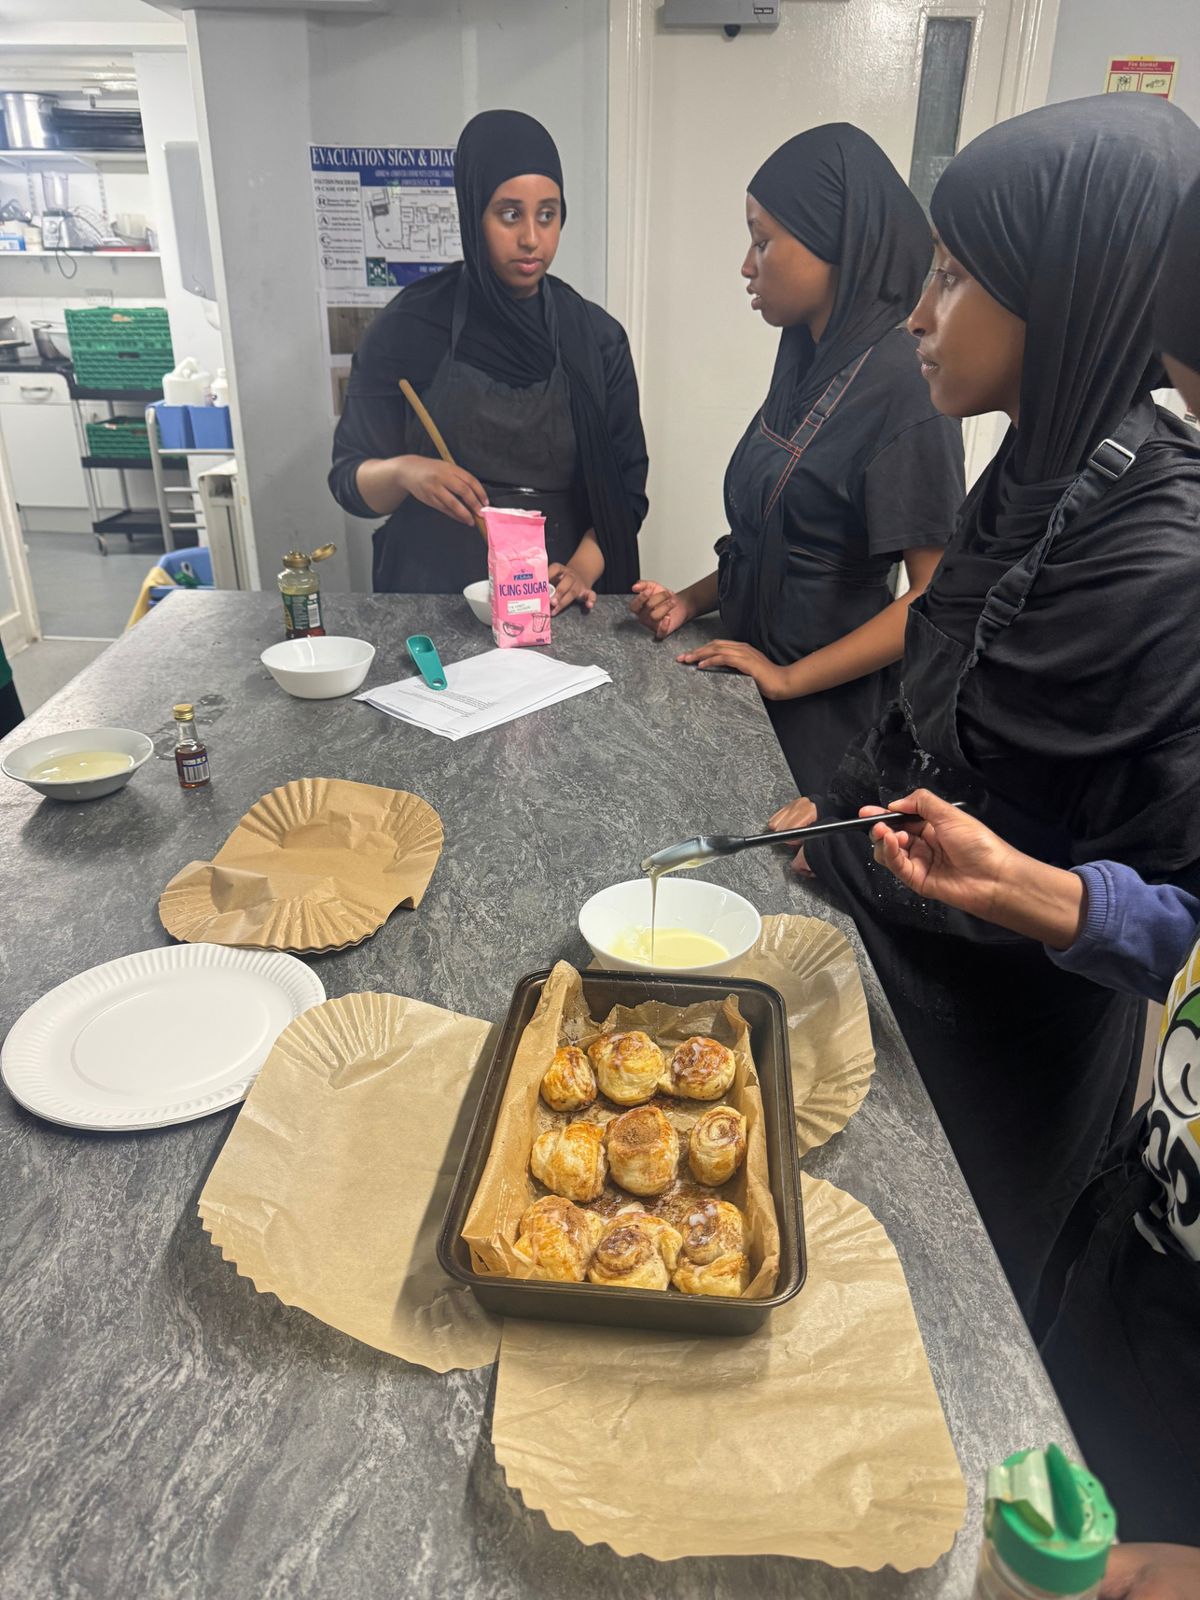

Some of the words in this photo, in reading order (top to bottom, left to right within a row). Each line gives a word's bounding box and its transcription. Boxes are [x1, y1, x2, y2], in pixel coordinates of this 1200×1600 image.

[312, 148, 385, 166] EVACUATION
[388, 149, 416, 166] SIGN
[418, 150, 427, 167] &
[499, 584, 522, 597] ICING
[522, 581, 548, 595] SUGAR
